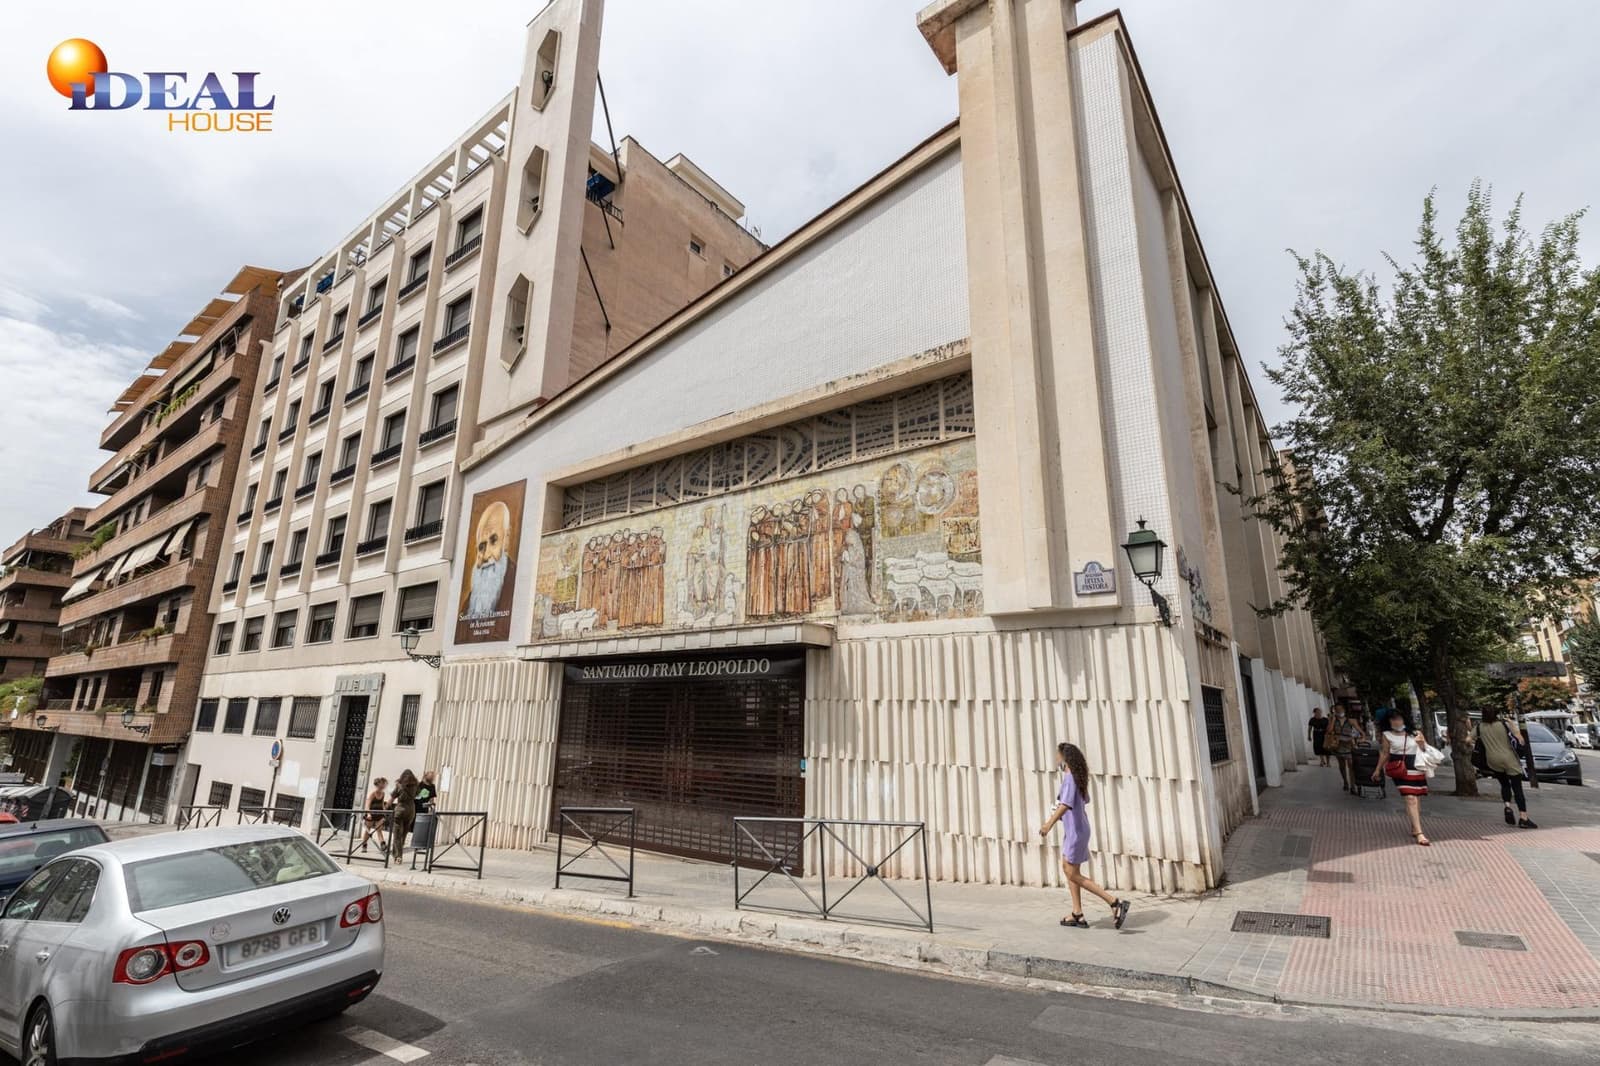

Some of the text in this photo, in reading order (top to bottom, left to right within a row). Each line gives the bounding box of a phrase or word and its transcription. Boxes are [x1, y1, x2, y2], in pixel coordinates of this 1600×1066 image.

[582, 657, 771, 679] SANTUARIO FRAY LEOPOLDO
[241, 926, 318, 959] 8798 GFB
